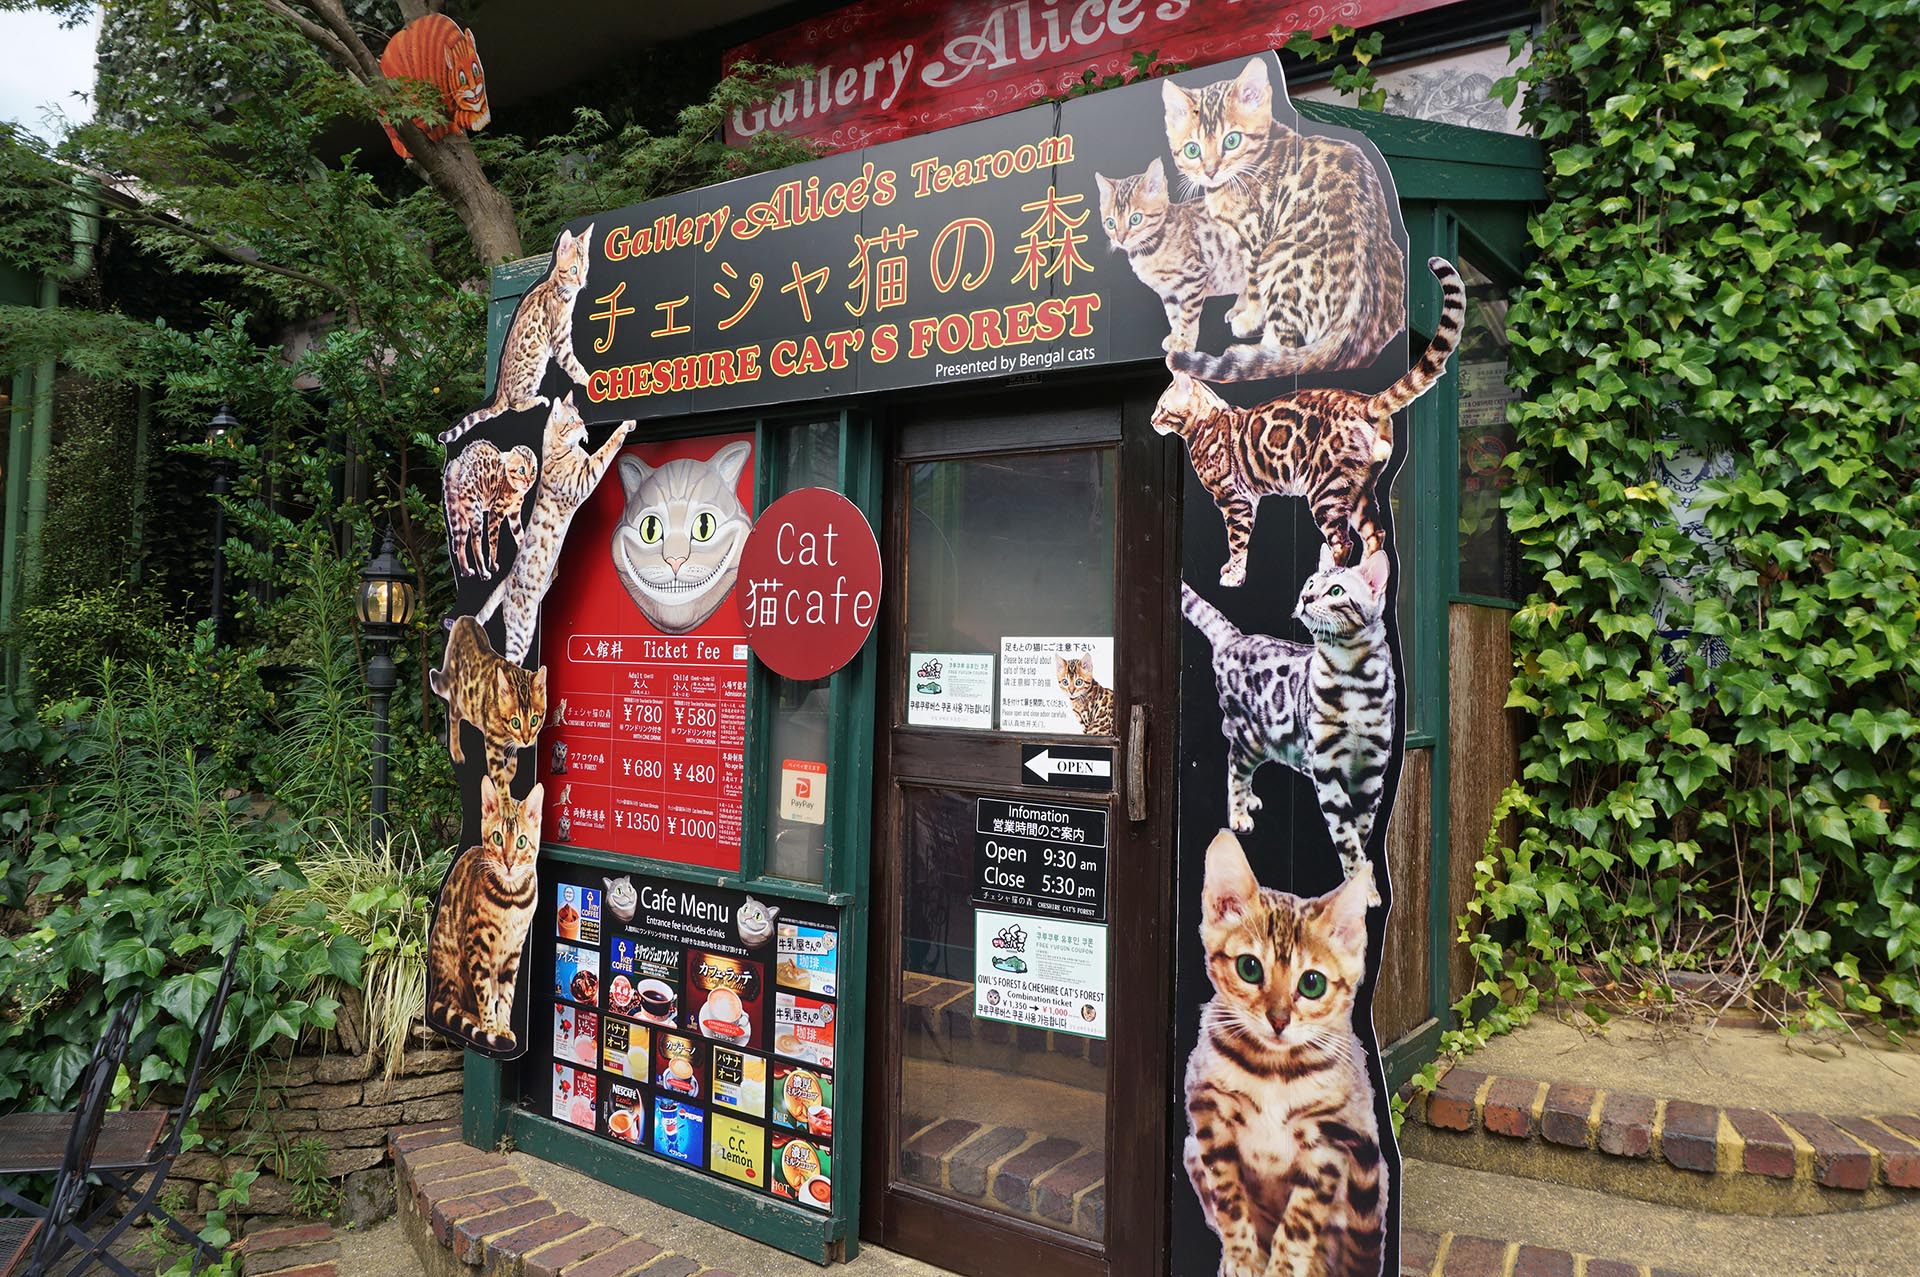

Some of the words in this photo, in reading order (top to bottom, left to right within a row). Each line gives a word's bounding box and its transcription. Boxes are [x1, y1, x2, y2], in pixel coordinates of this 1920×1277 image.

[732, 44, 914, 136] Gallery
[921, 0, 1191, 87] Alices
[604, 205, 730, 261] Gallery
[731, 162, 896, 240] Alice's
[912, 134, 1073, 198] Tearoom
[590, 186, 1095, 353] チェシャ猫の森
[587, 345, 761, 403] CHESHIRE
[771, 324, 899, 377] CAT'S
[910, 294, 1100, 359] FOREST
[936, 356, 997, 377] Presented
[1001, 356, 1016, 372] by
[1020, 348, 1064, 368] Bengal
[1068, 347, 1095, 361] cats
[777, 522, 838, 566] Cat
[744, 576, 872, 628] 猫cafe
[583, 640, 623, 660] 入館料
[644, 641, 688, 658] Ticket
[697, 641, 720, 660] fee
[1005, 642, 1096, 652] 足もとの猫にご注意下さい
[634, 680, 648, 688] 大人
[673, 683, 688, 692] 小人
[624, 704, 662, 724] ¥780
[942, 702, 951, 712] 쿠폰
[952, 703, 963, 713] 사용
[675, 707, 716, 727] ¥580
[570, 753, 605, 764] フクロウの森
[1057, 760, 1094, 774] OPEN
[622, 759, 662, 778] ¥680
[672, 762, 715, 784] ¥480
[791, 798, 814, 810] PayPay
[615, 810, 660, 832] ¥1350
[1008, 804, 1070, 824] Infomation
[667, 816, 716, 840] ¥1000
[993, 818, 1085, 842] 営業時間のご案内
[986, 841, 1027, 863] Open
[1044, 849, 1076, 869] 9:30
[1080, 860, 1097, 872] am
[984, 866, 1025, 888] Close
[1041, 874, 1075, 896] 5:30
[1078, 886, 1096, 898] pm
[641, 886, 676, 913] Cafe
[680, 893, 729, 923] Menu
[983, 891, 1032, 906] チェシャ猫の森
[1038, 902, 1060, 911] CHESHIRE
[1062, 905, 1076, 913] CAT'S
[1077, 907, 1095, 916] FOREST
[646, 916, 671, 928] Entrance
[672, 920, 682, 930] fee
[682, 922, 706, 935] includes
[707, 927, 726, 938] drinks
[779, 938, 822, 952] 牛乳屋さんの
[612, 960, 632, 972] COFFEE
[799, 954, 820, 970] 珈琲
[978, 974, 998, 986] OWL'S
[998, 977, 1021, 989] FOREST
[1022, 981, 1027, 990] &
[1028, 982, 1059, 995] CHESHIRE
[1060, 987, 1078, 999] CAT'S
[1080, 990, 1104, 1002] FOREST
[1007, 990, 1051, 1004] Combination
[1052, 999, 1072, 1008] ticket
[776, 1008, 819, 1023] 牛乳屋さんの
[978, 1004, 1011, 1018] 쿠루쿠루버스
[1012, 1010, 1024, 1022] 쿠폰
[1025, 1012, 1036, 1024] 사용
[1038, 1014, 1067, 1028] 가능합니다
[578, 1019, 595, 1031] いちご
[607, 1023, 628, 1036] バナナ
[796, 1025, 817, 1041] 珈琲
[578, 1028, 596, 1040] オーレ
[608, 1037, 627, 1050] オーレ
[718, 1054, 741, 1067] バナナ
[821, 1058, 832, 1066] Hot
[718, 1068, 740, 1082] オーレ
[577, 1080, 594, 1093] いちご
[577, 1088, 595, 1101] オーレ
[774, 1111, 788, 1122] ICE
[729, 1136, 748, 1154] C.C.
[722, 1148, 753, 1168] Lemon
[772, 1180, 790, 1194] HOT
